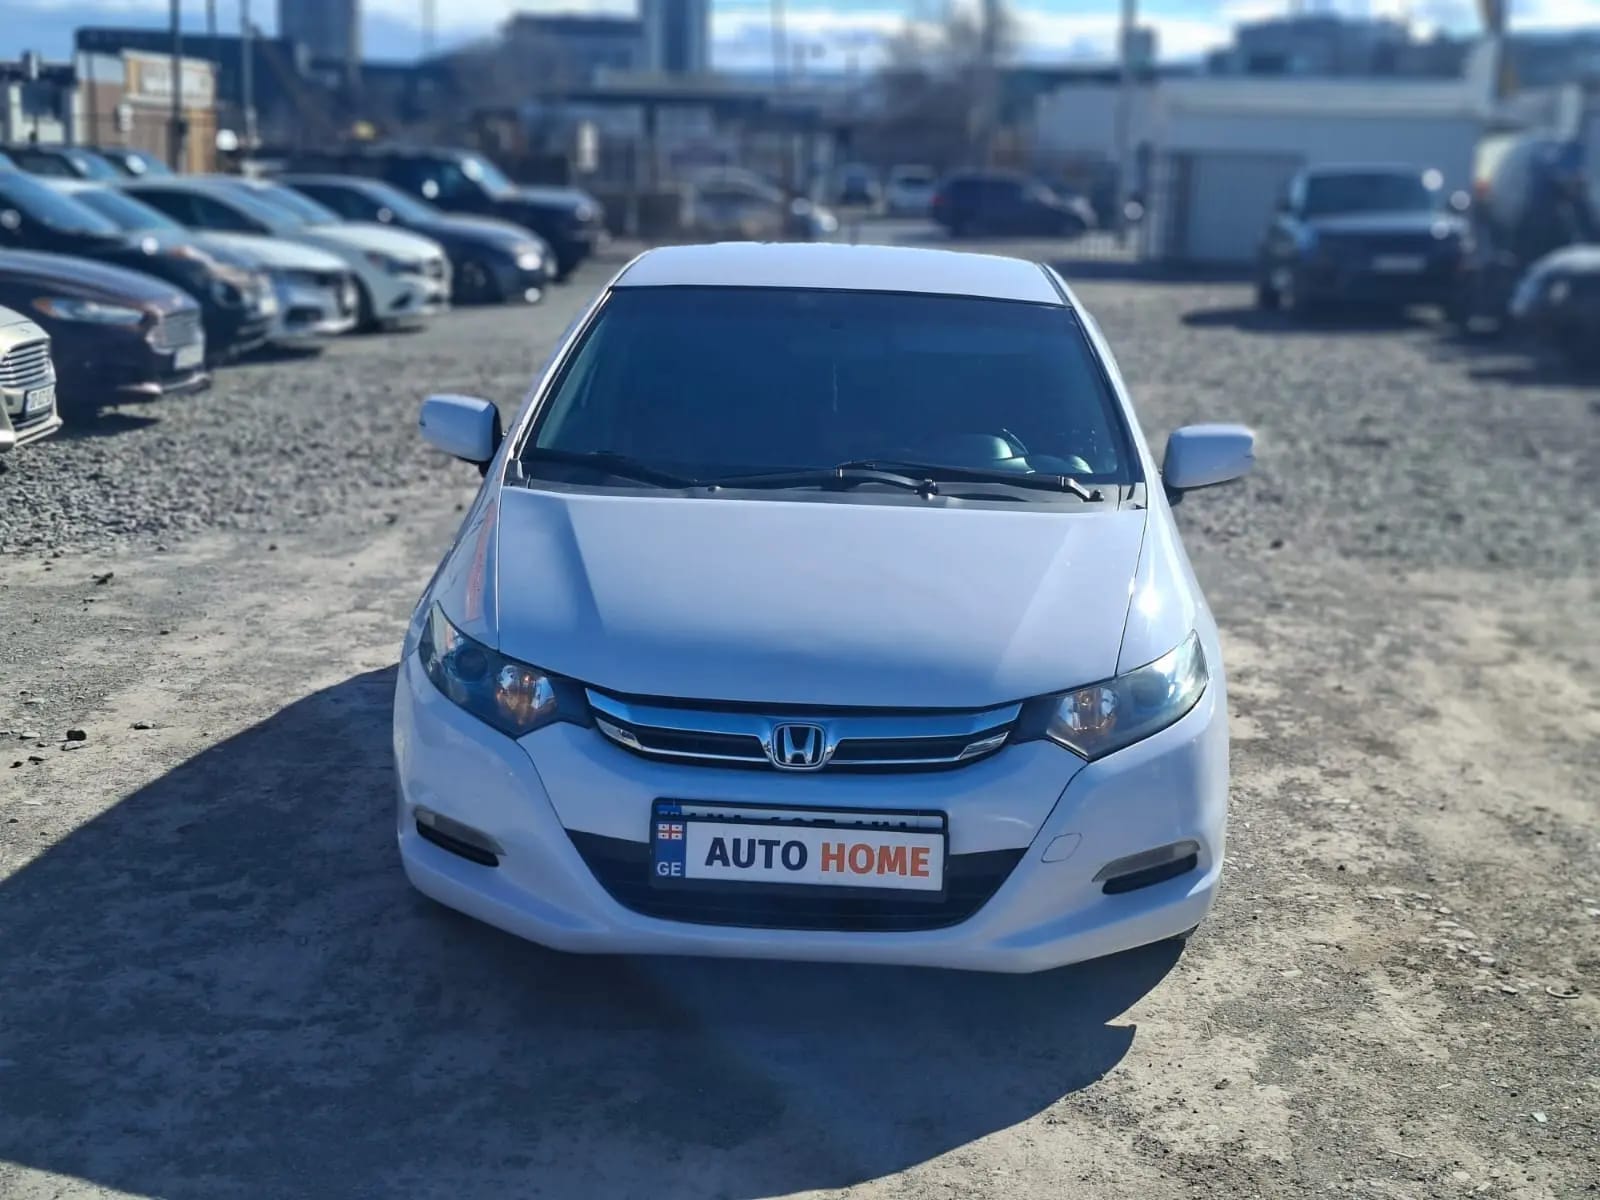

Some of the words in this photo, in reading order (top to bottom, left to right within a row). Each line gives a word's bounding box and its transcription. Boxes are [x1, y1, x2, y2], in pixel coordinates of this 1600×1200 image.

[656, 861, 682, 877] GE
[705, 837, 808, 871] AUTO
[821, 842, 931, 877] HOME
